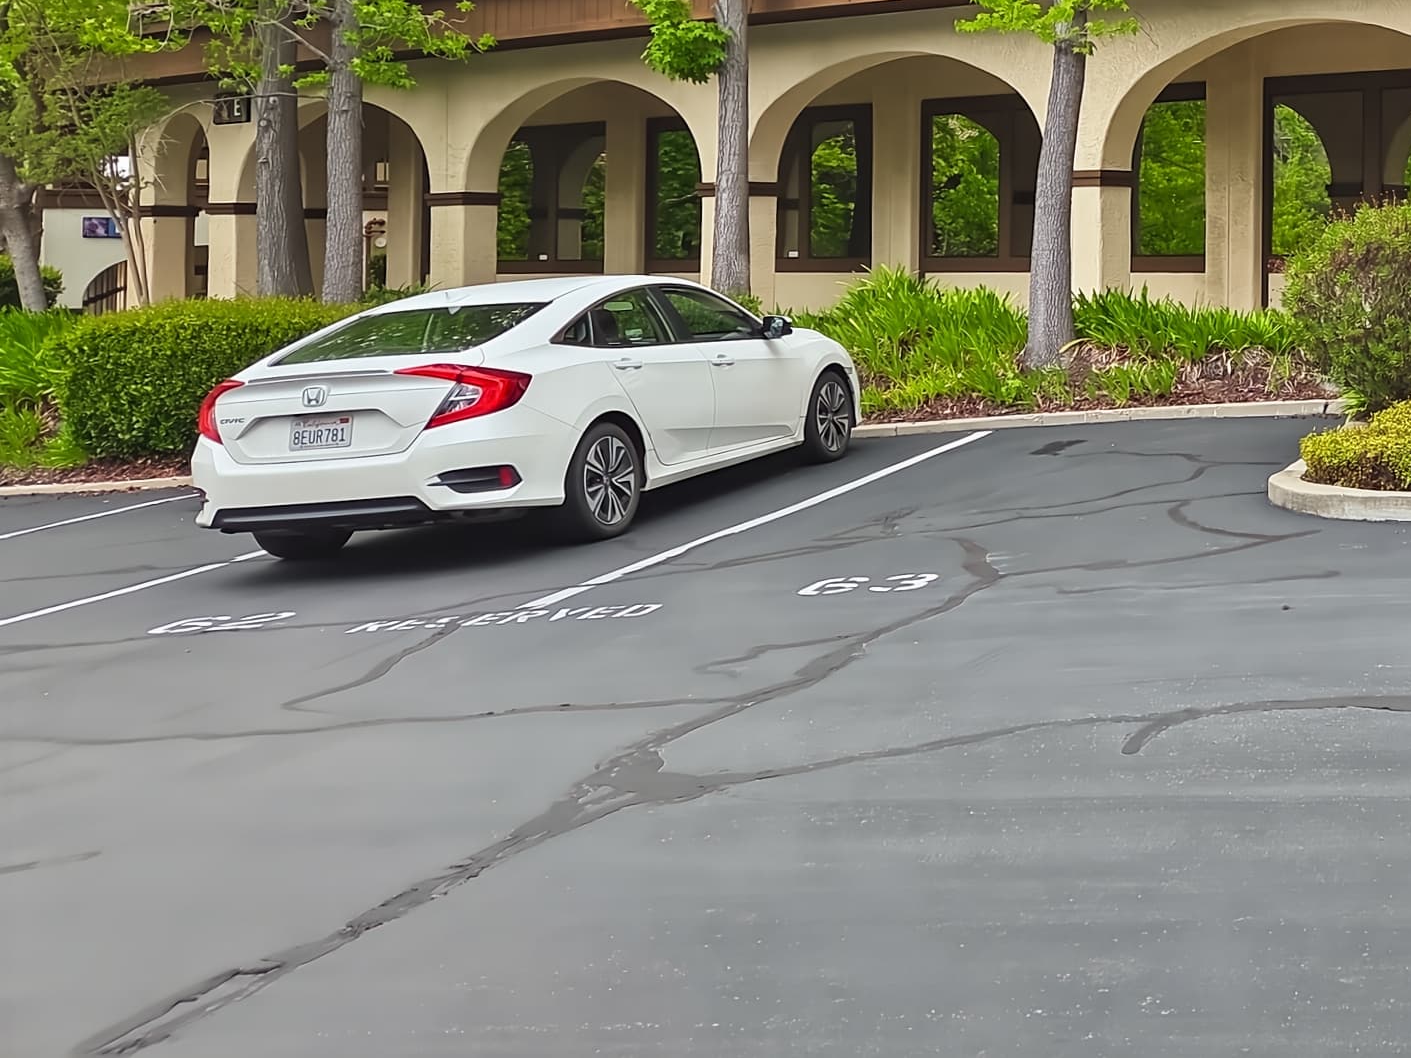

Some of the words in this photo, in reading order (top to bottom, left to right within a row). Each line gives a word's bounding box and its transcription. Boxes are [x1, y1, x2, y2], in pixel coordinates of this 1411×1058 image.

[292, 427, 346, 446] 8EUR781
[797, 573, 939, 596] 63
[146, 611, 297, 635] 62
[344, 603, 664, 634] RESERVED
